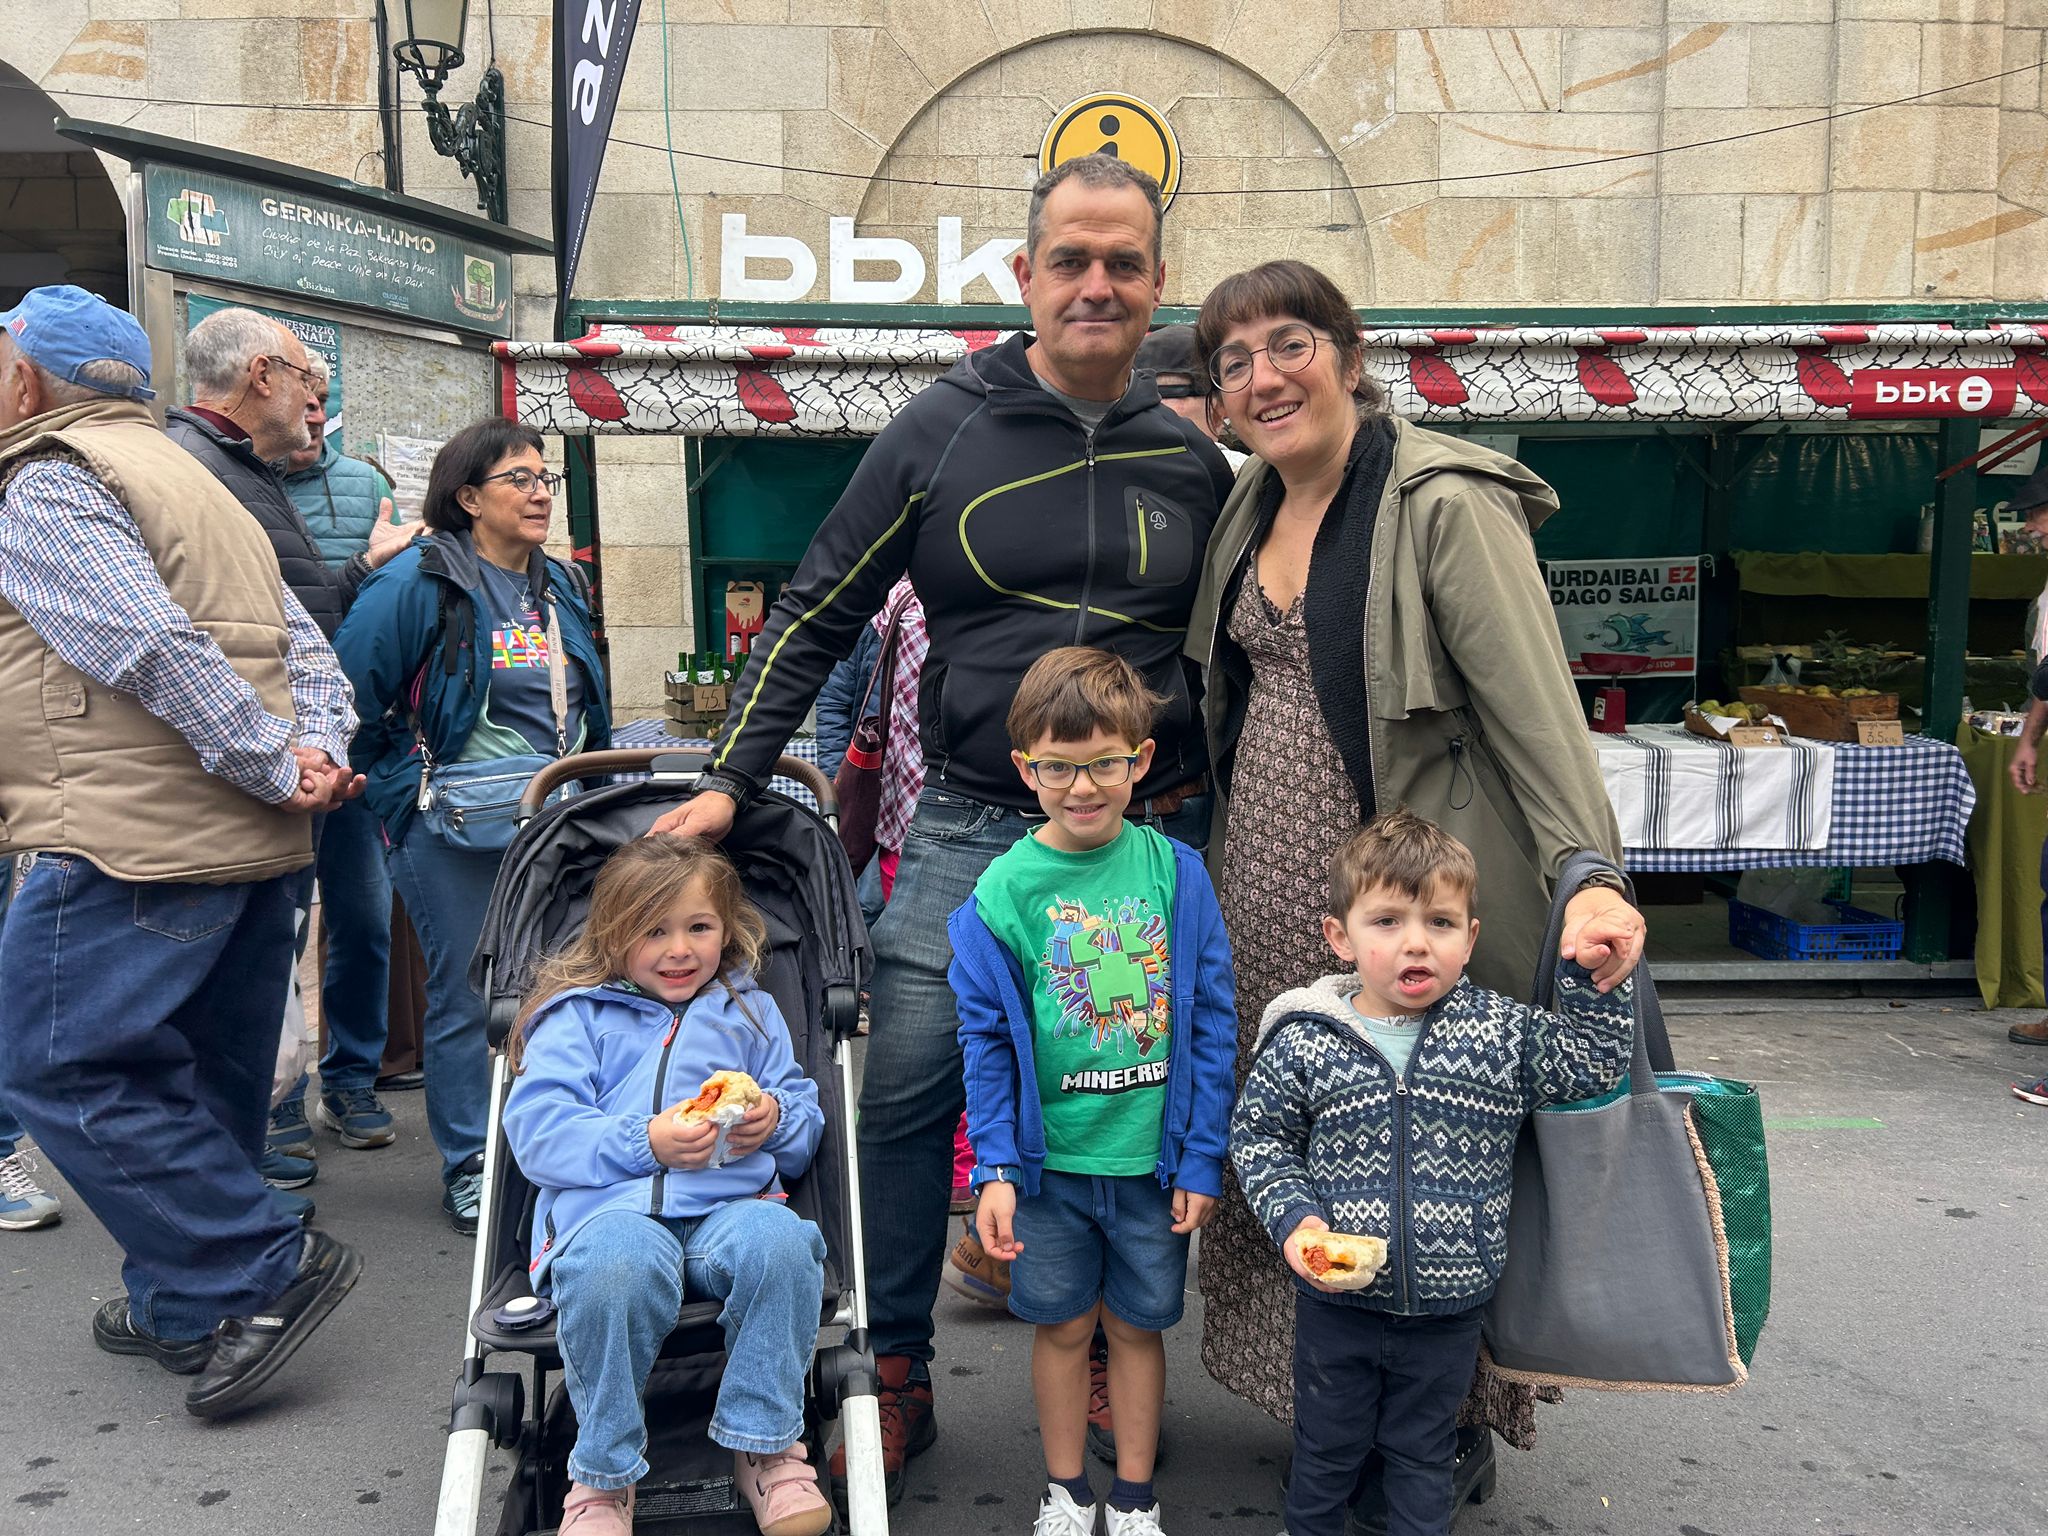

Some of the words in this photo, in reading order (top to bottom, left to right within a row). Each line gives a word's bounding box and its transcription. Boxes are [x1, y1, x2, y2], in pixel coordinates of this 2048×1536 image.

[260, 198, 436, 254] GERNIKA-LUMO
[720, 213, 1030, 304] bbk
[306, 281, 335, 294] Bizkaia
[270, 316, 335, 336] NIFESTAZIO
[1875, 381, 1952, 403] bbk
[1551, 568, 1659, 588] URDAIBAI
[1668, 566, 1696, 584] EZ
[1551, 588, 1612, 606] DAGO
[1618, 585, 1696, 604] SALGAI
